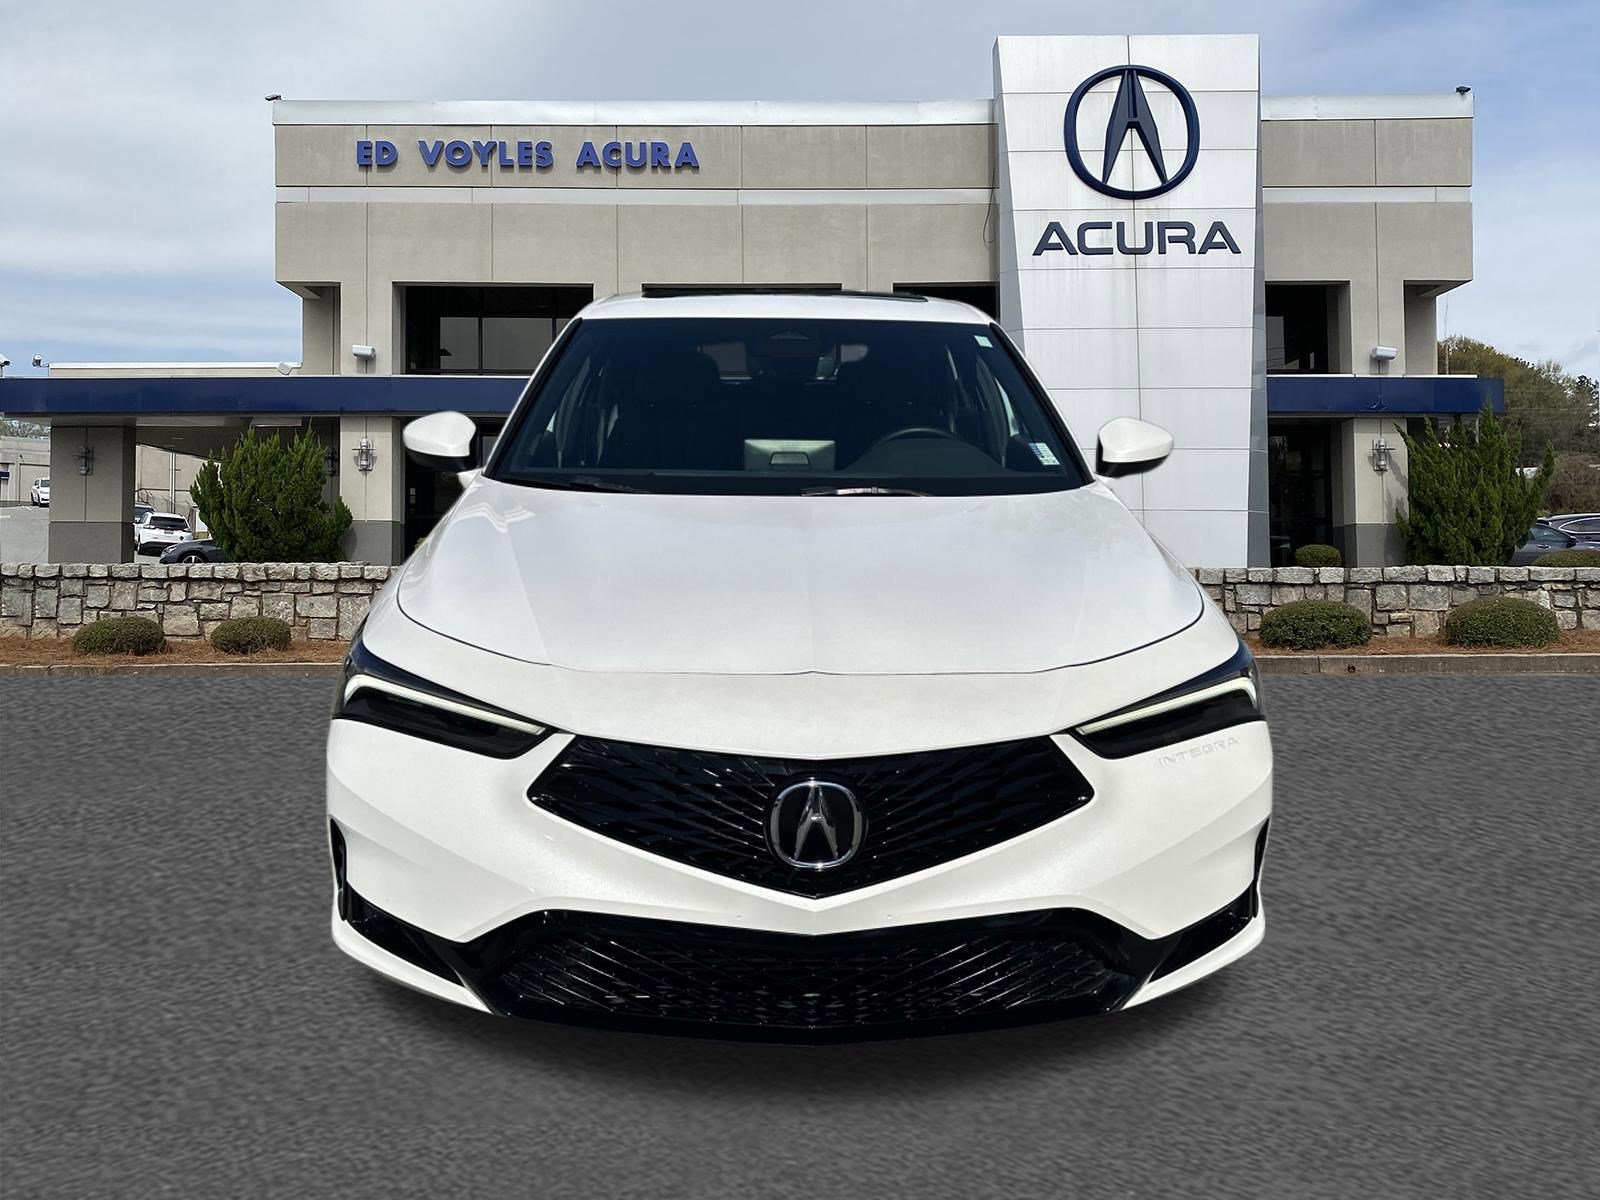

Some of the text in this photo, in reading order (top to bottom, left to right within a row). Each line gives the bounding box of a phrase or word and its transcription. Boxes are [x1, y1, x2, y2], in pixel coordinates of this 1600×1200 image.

[356, 140, 700, 168] ED VOYLES ACURA
[1032, 221, 1242, 255] ACURA
[1158, 737, 1239, 767] INTEGRA
